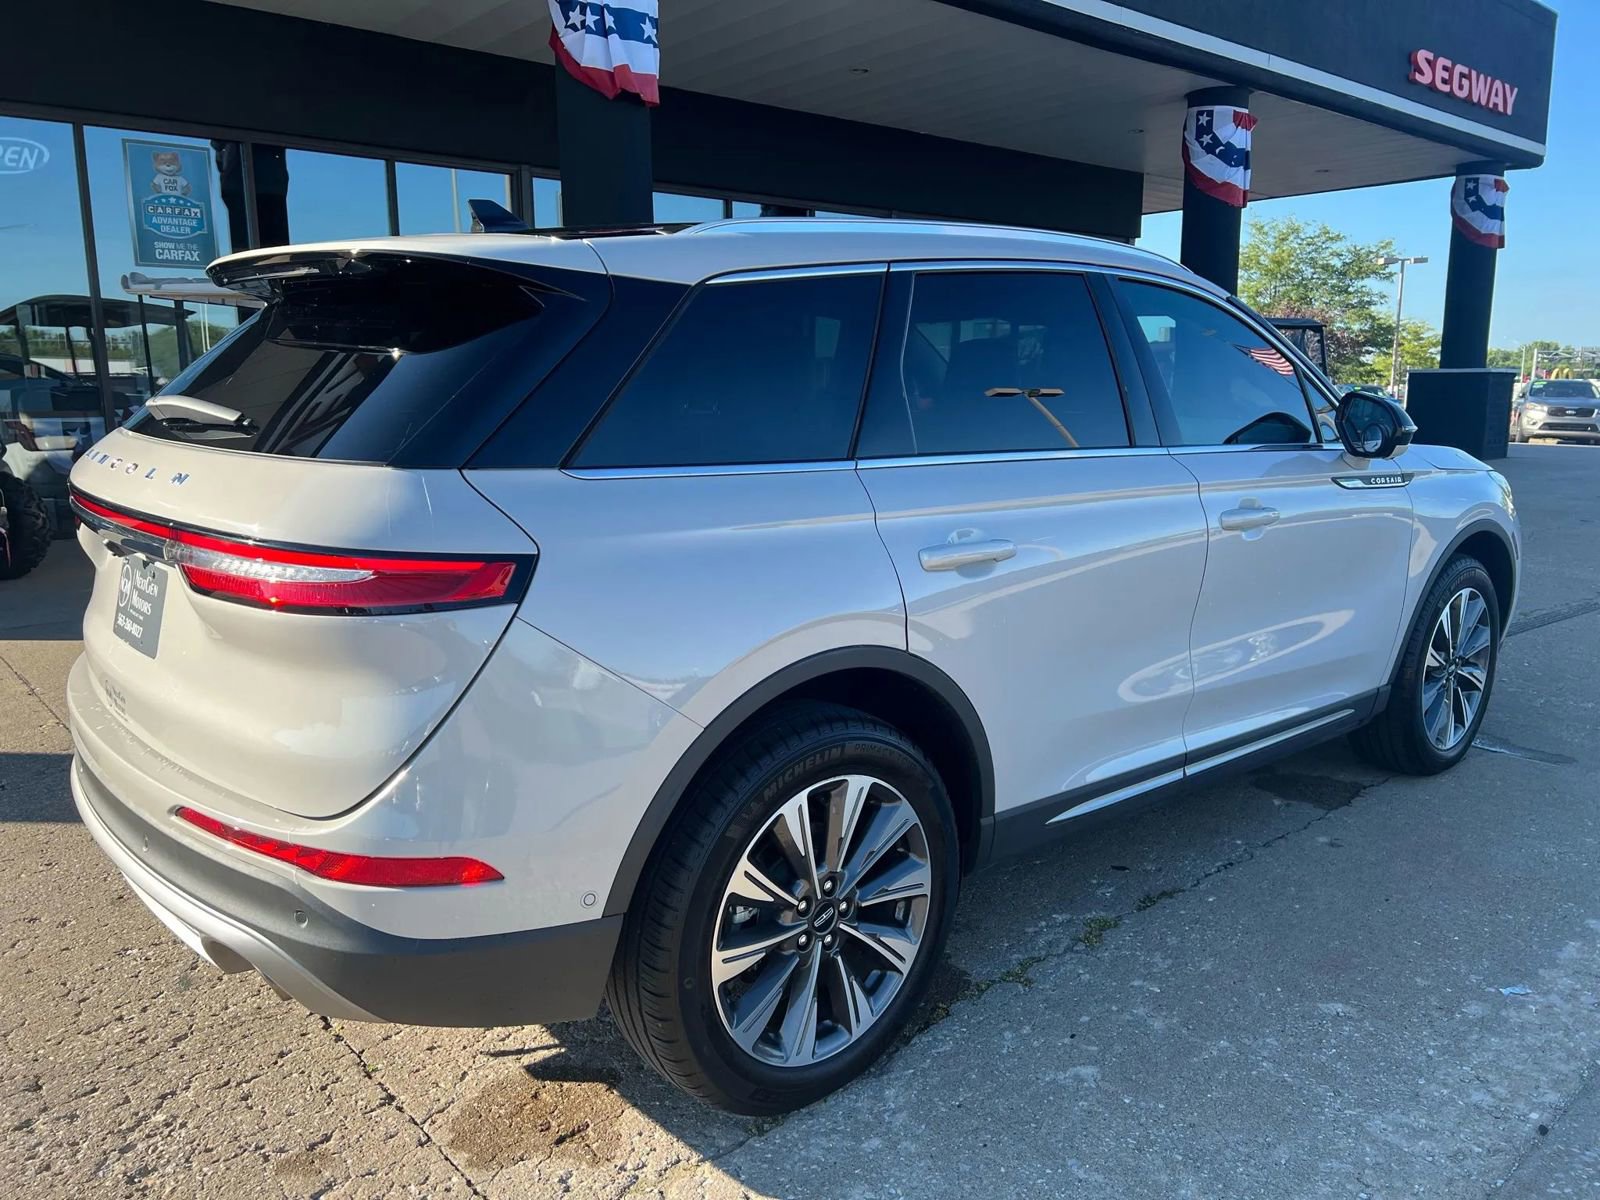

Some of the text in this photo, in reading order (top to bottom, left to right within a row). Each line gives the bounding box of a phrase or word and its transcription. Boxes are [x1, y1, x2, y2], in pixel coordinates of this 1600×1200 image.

[1412, 48, 1518, 116] SEGWAY
[163, 178, 178, 187] CAR
[148, 205, 200, 218] CARFAX
[152, 216, 198, 227] ADVANTAGE
[161, 225, 191, 234] DEALER
[154, 241, 175, 250] SHOW
[155, 249, 201, 262] CARFAX
[86, 448, 190, 485] LINCOLN
[1370, 476, 1402, 484] CORSAIR
[763, 743, 846, 801] MICHELIN
